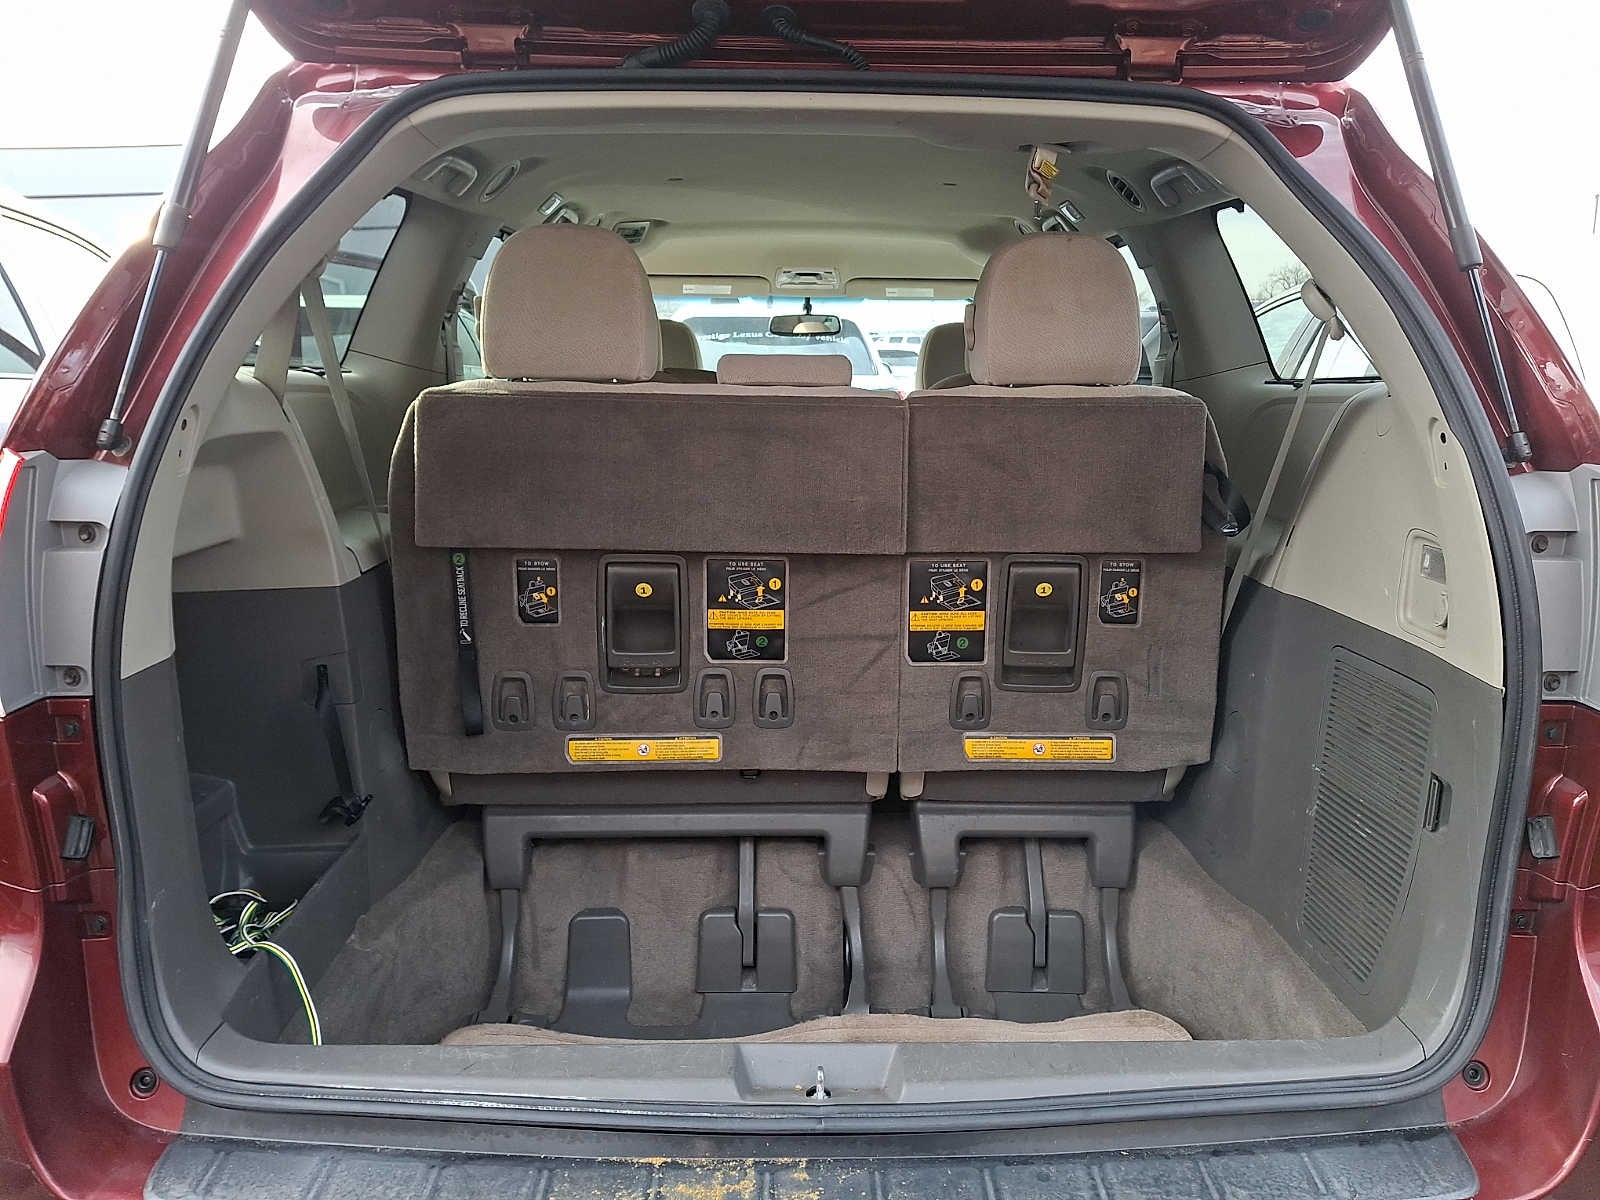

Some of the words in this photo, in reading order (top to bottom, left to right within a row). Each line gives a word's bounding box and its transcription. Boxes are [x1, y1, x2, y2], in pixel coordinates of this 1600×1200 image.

[456, 566, 467, 596] SEATBACK
[458, 596, 468, 620] RECLINE
[460, 620, 469, 628] TO
